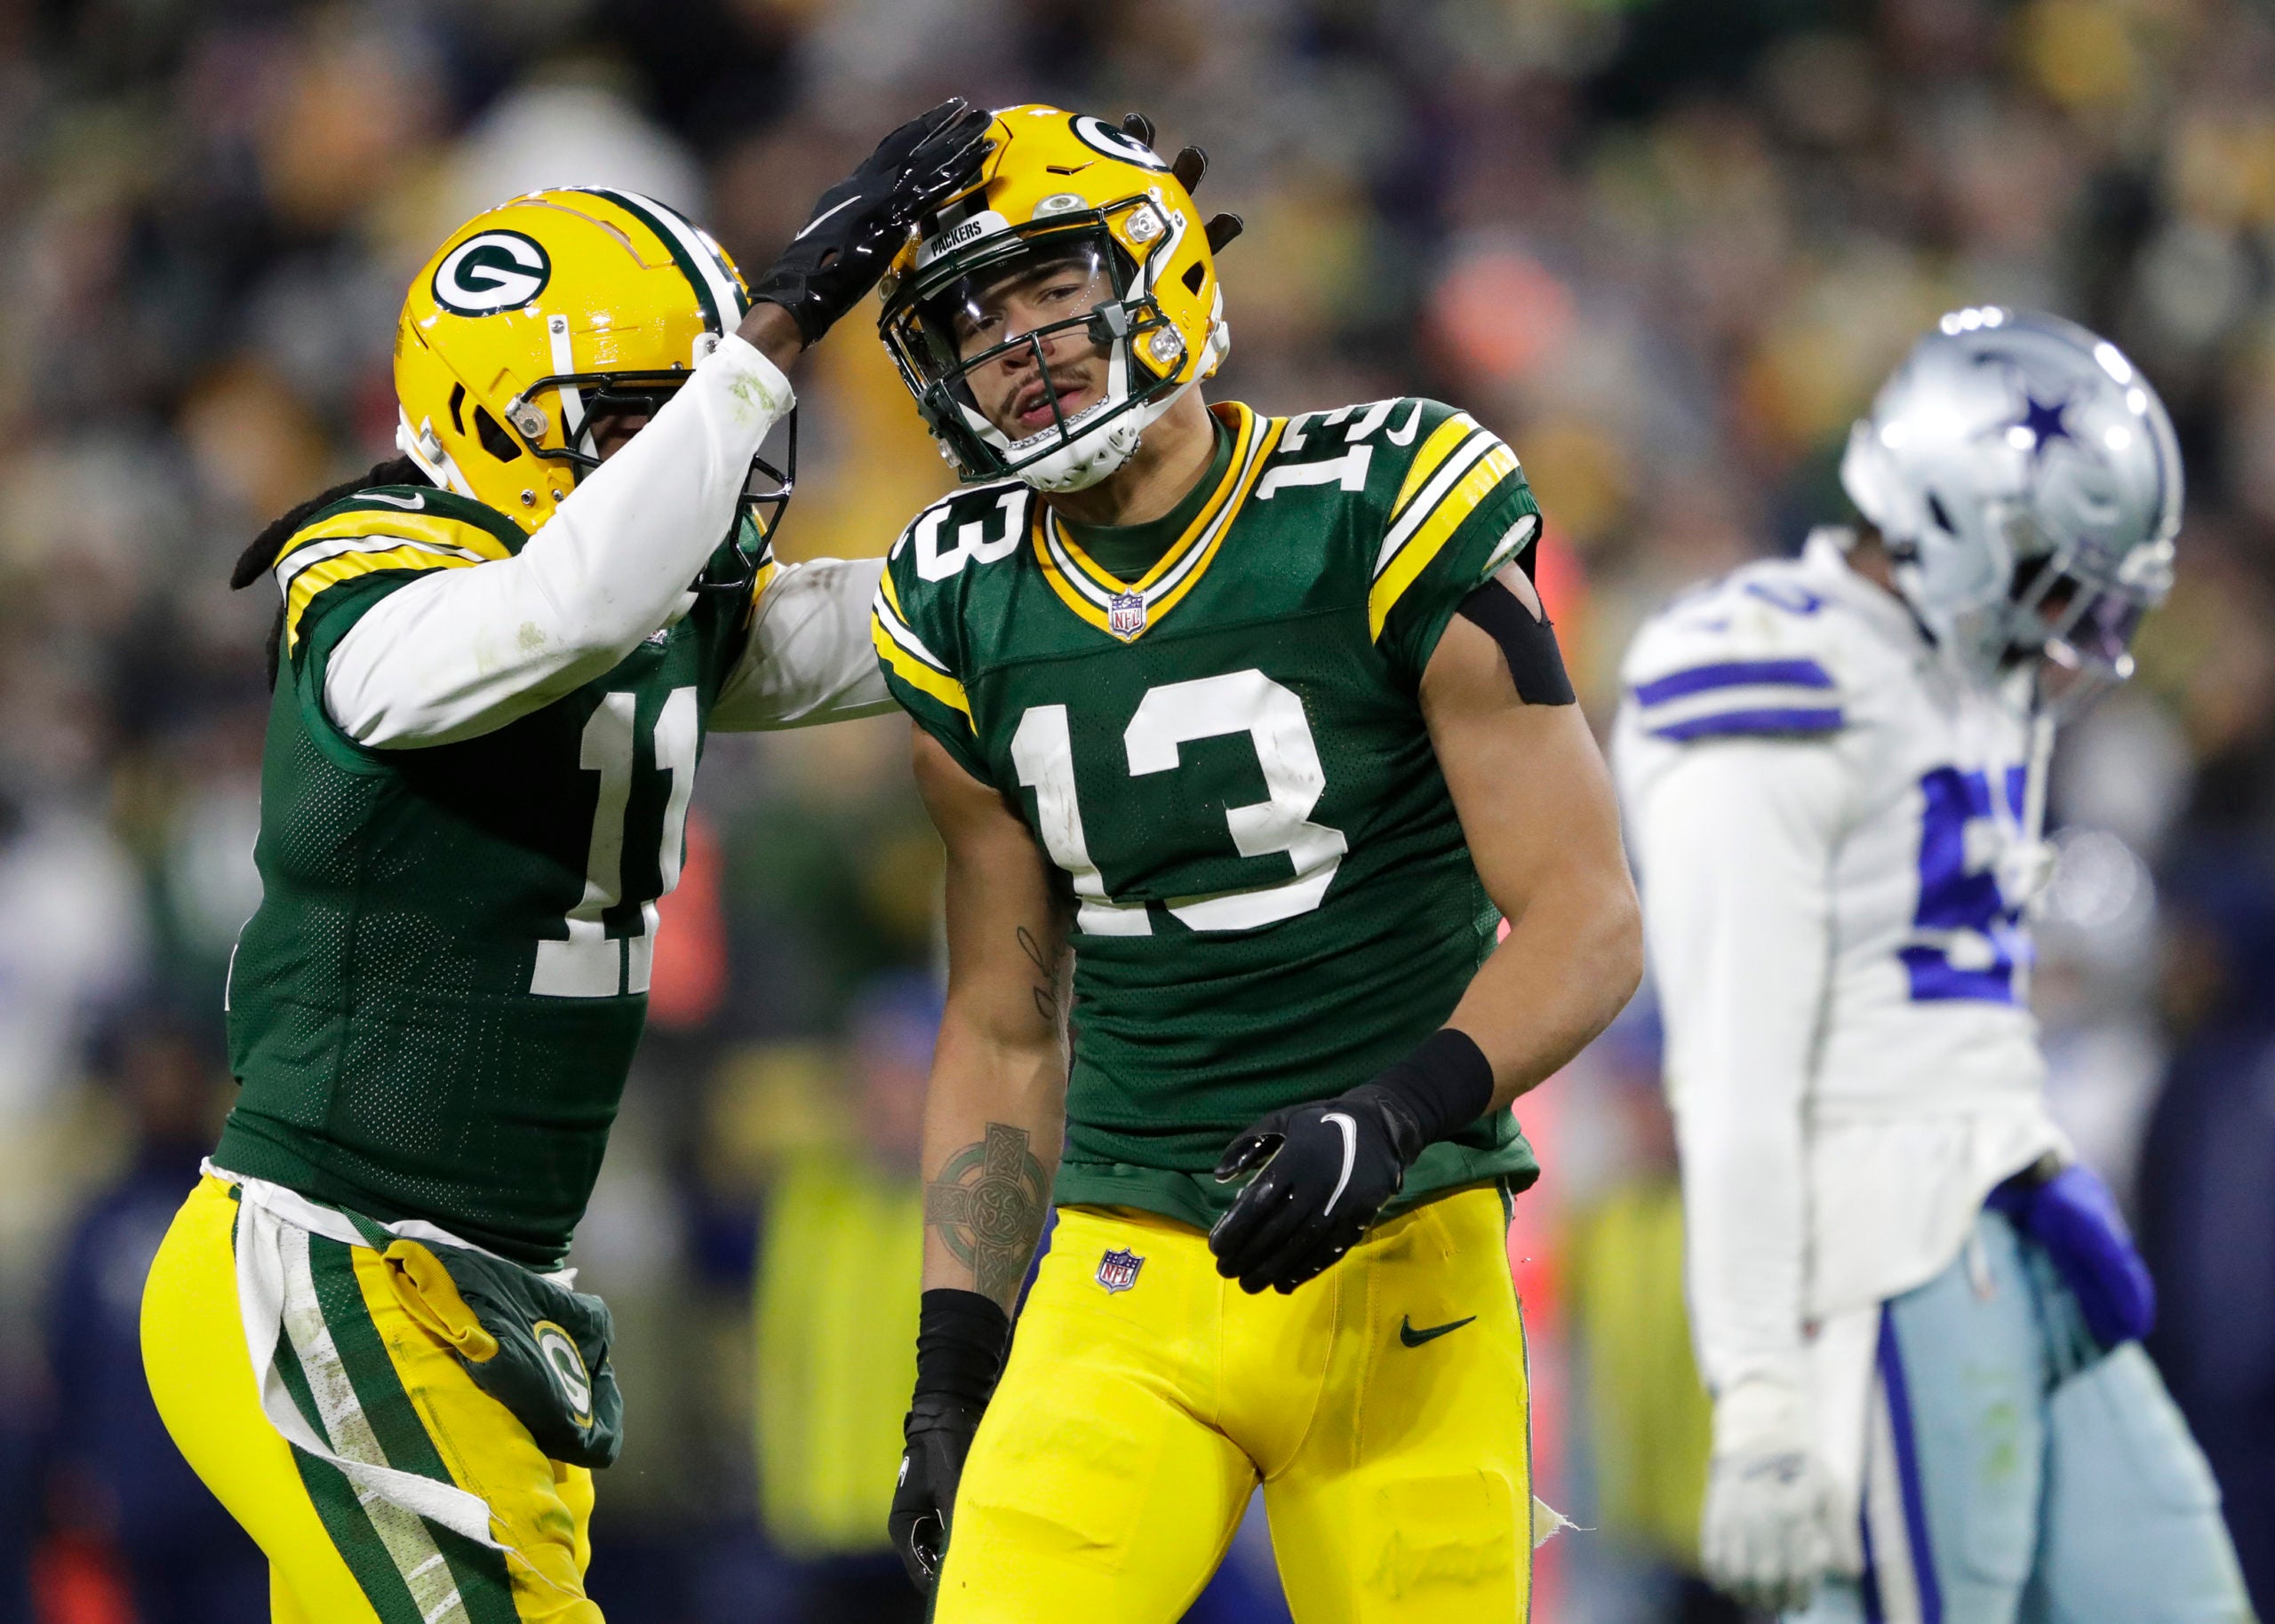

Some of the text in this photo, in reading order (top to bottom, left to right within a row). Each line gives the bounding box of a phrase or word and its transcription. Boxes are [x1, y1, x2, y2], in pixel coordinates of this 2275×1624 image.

[435, 233, 547, 312] G
[930, 220, 982, 257] PACKERS
[914, 480, 1029, 583] 3
[1114, 610, 1140, 630] NFL
[530, 686, 698, 997] 11
[1010, 668, 1348, 935] 13
[1102, 1263, 1130, 1284] NFL
[540, 1332, 591, 1416] G
